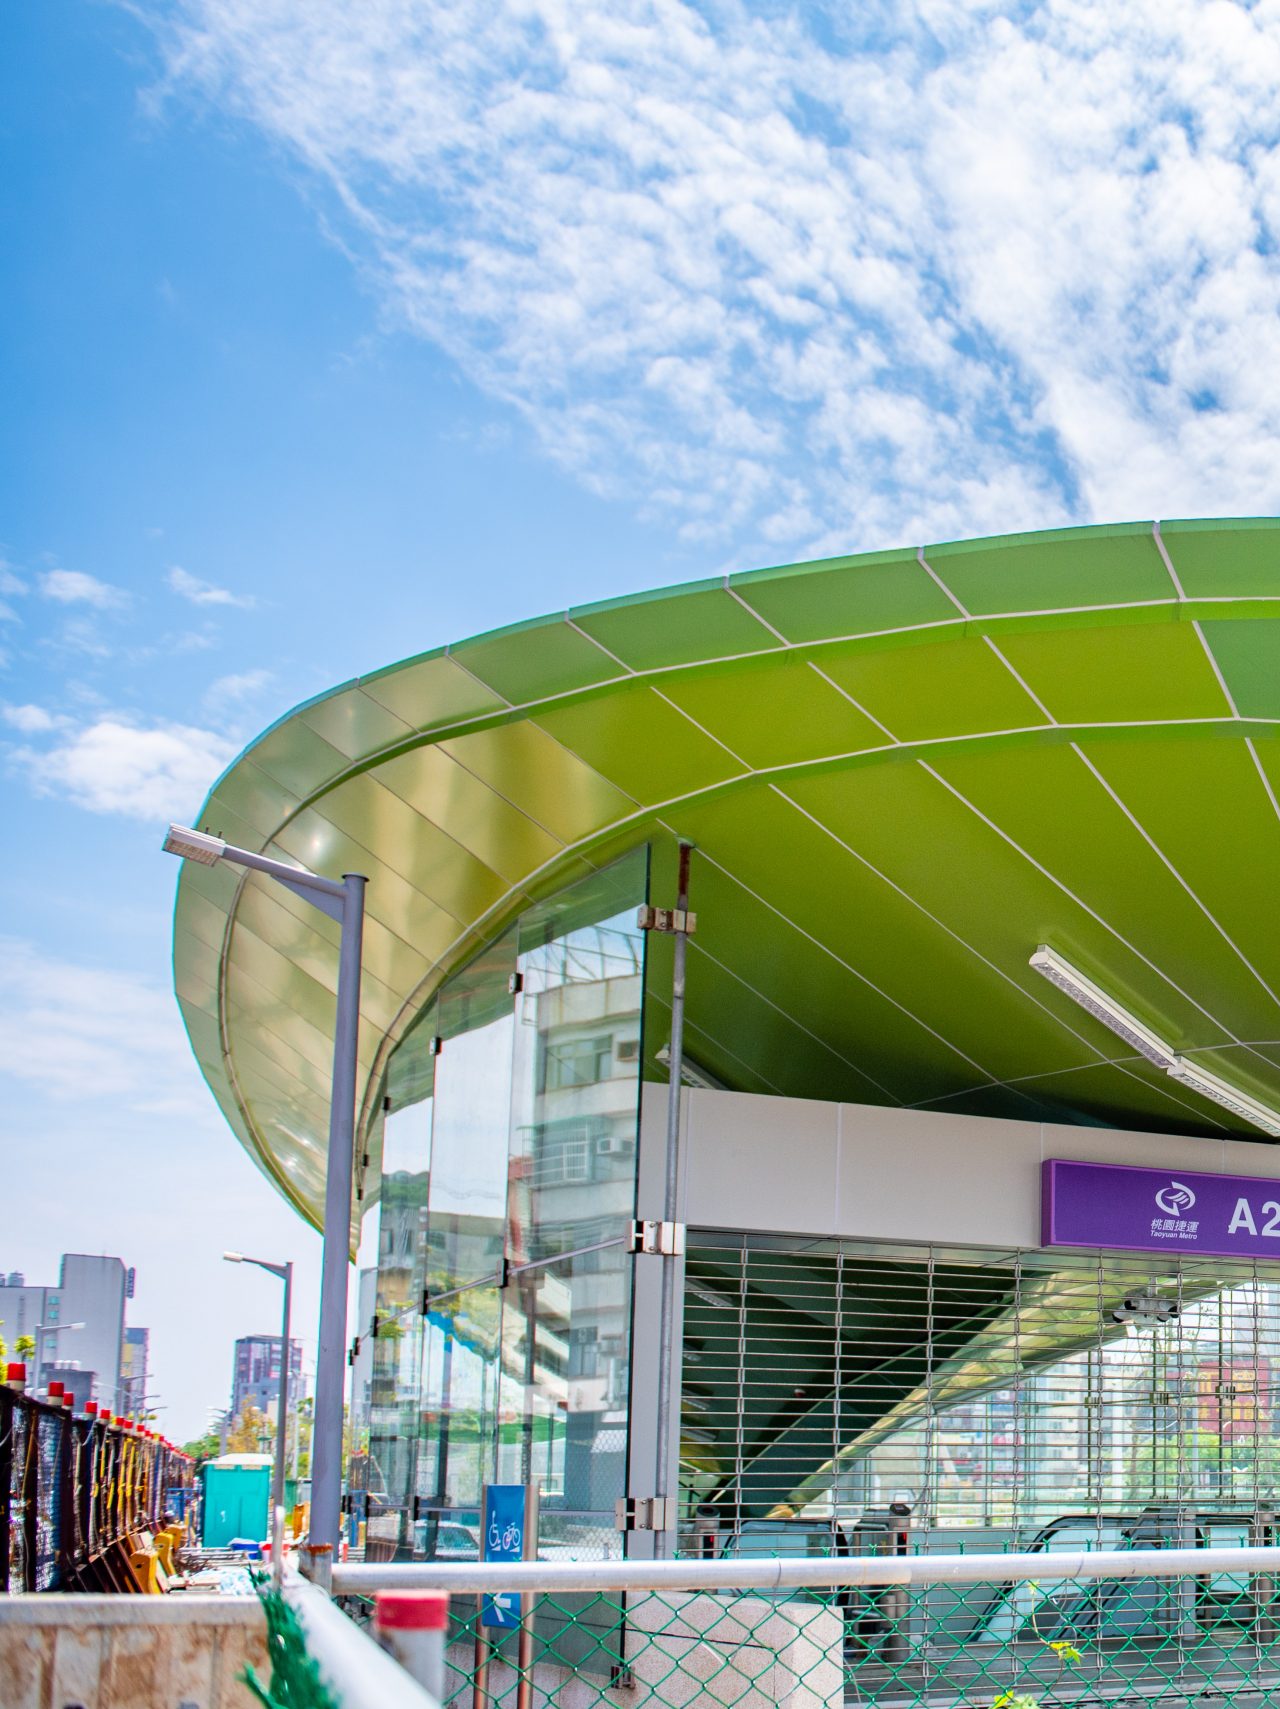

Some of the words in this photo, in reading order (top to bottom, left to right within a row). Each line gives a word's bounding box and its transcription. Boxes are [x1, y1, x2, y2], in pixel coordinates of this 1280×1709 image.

[1151, 1218, 1199, 1233] 桃園捷運
[1150, 1230, 1178, 1239] Taoyuan
[1179, 1232, 1198, 1240] Metro
